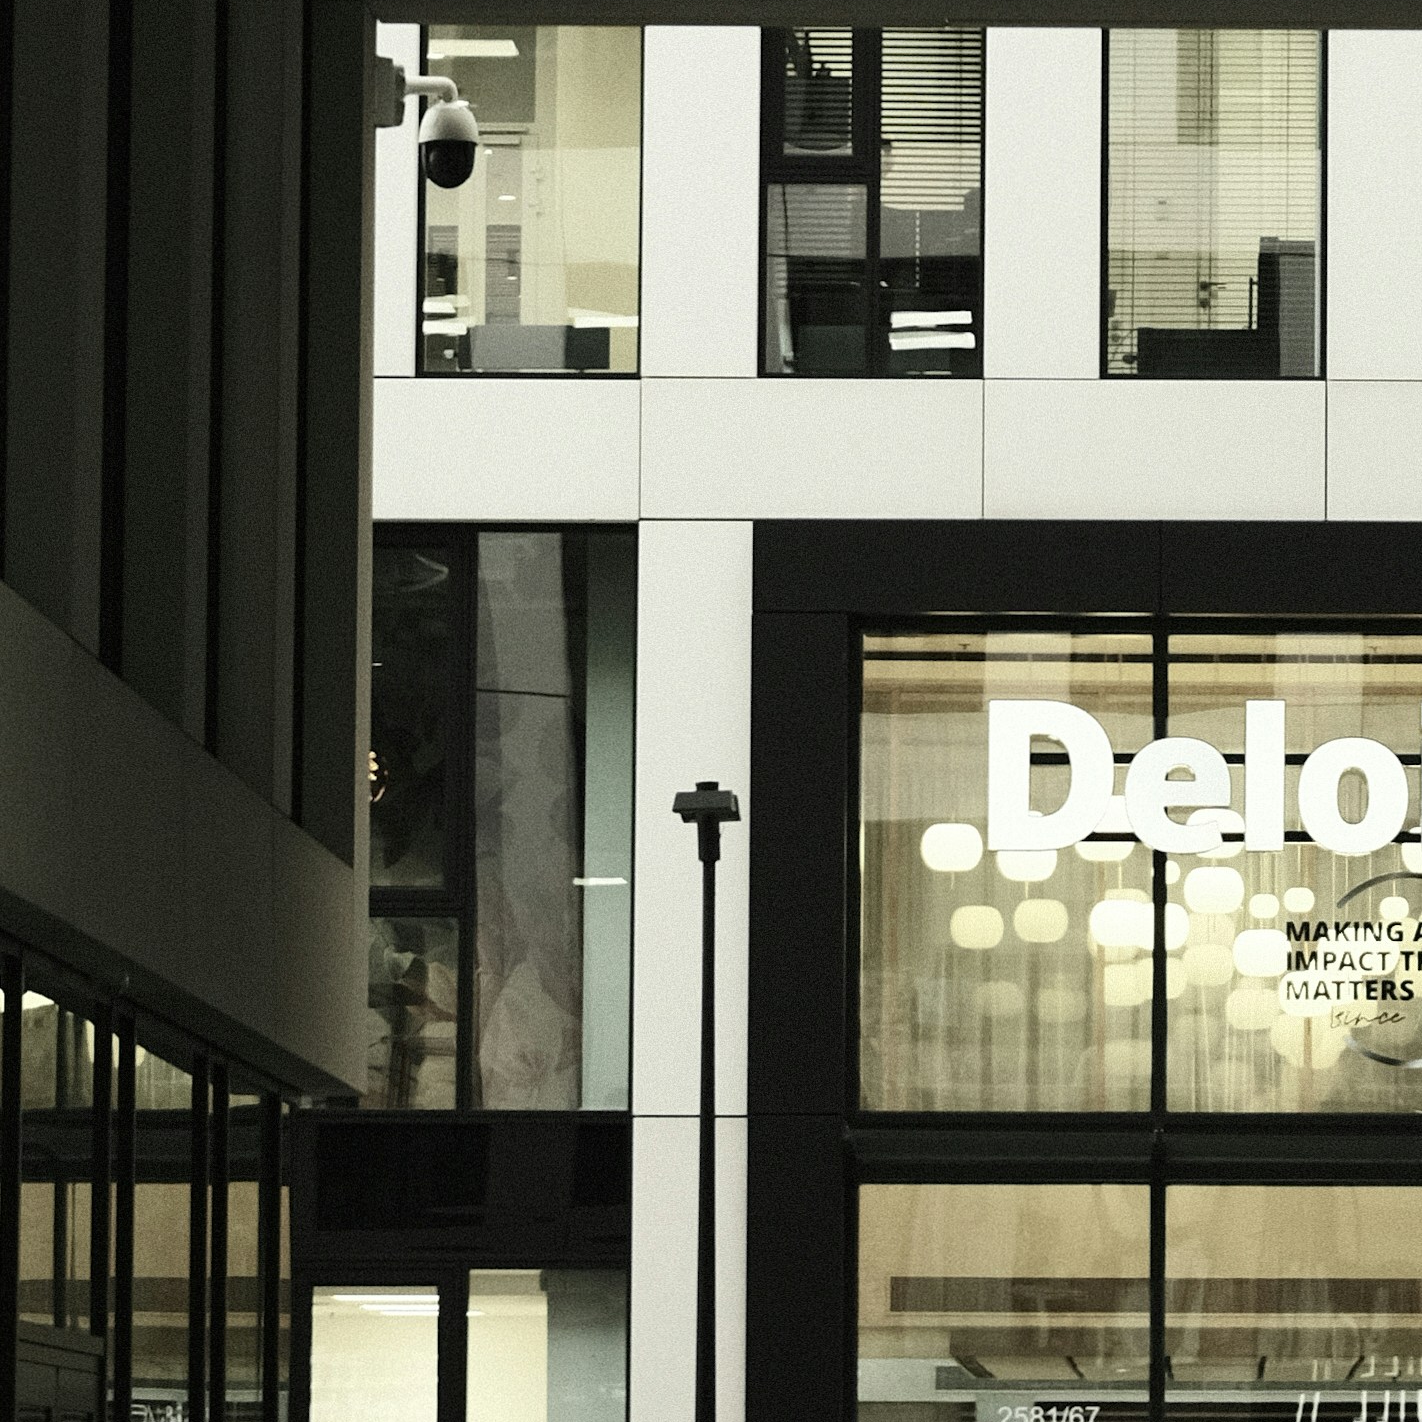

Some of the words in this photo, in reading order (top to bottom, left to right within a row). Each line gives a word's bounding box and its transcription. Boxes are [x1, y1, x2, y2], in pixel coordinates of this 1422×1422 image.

[1286, 921, 1404, 942] MAKING
[1286, 951, 1391, 971] IMPACT
[1286, 980, 1415, 1001] MATTERS
